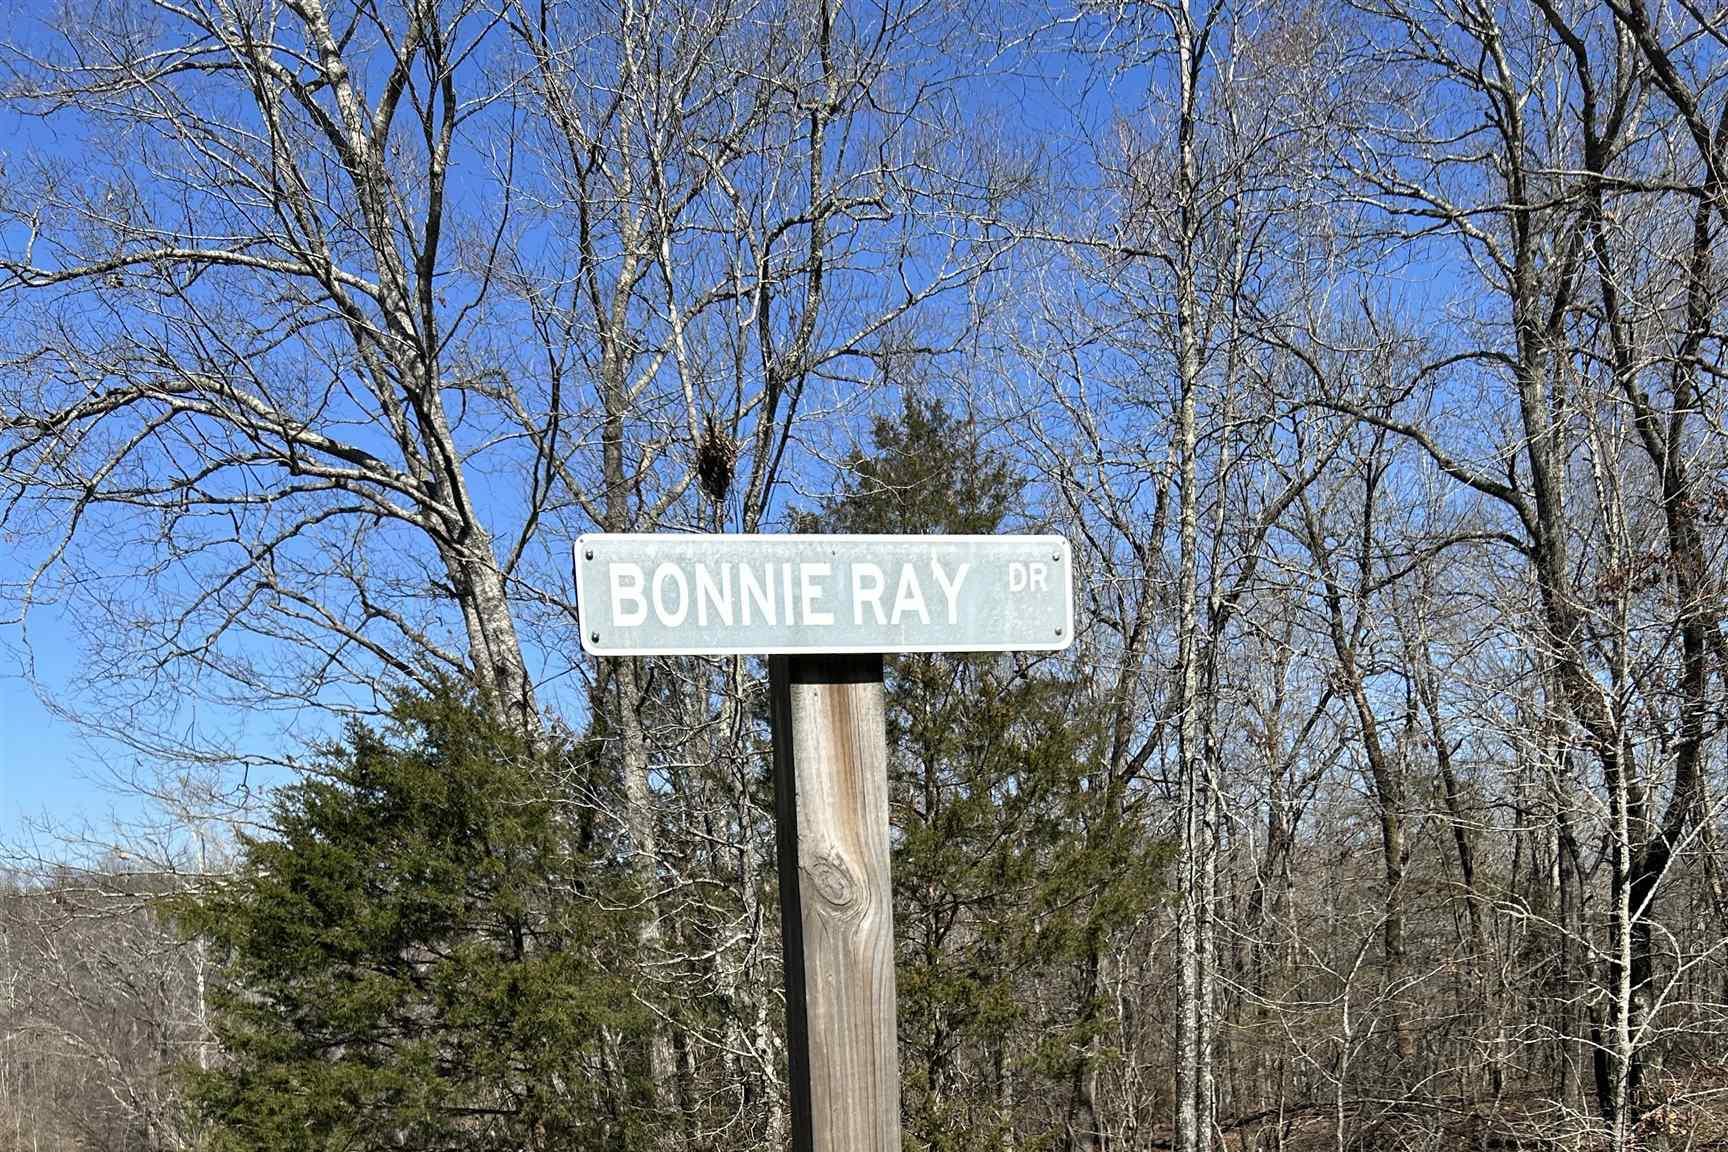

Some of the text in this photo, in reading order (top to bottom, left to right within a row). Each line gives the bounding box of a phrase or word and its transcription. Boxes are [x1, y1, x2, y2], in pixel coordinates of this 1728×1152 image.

[608, 561, 1050, 628] BONNIE RAY DR
